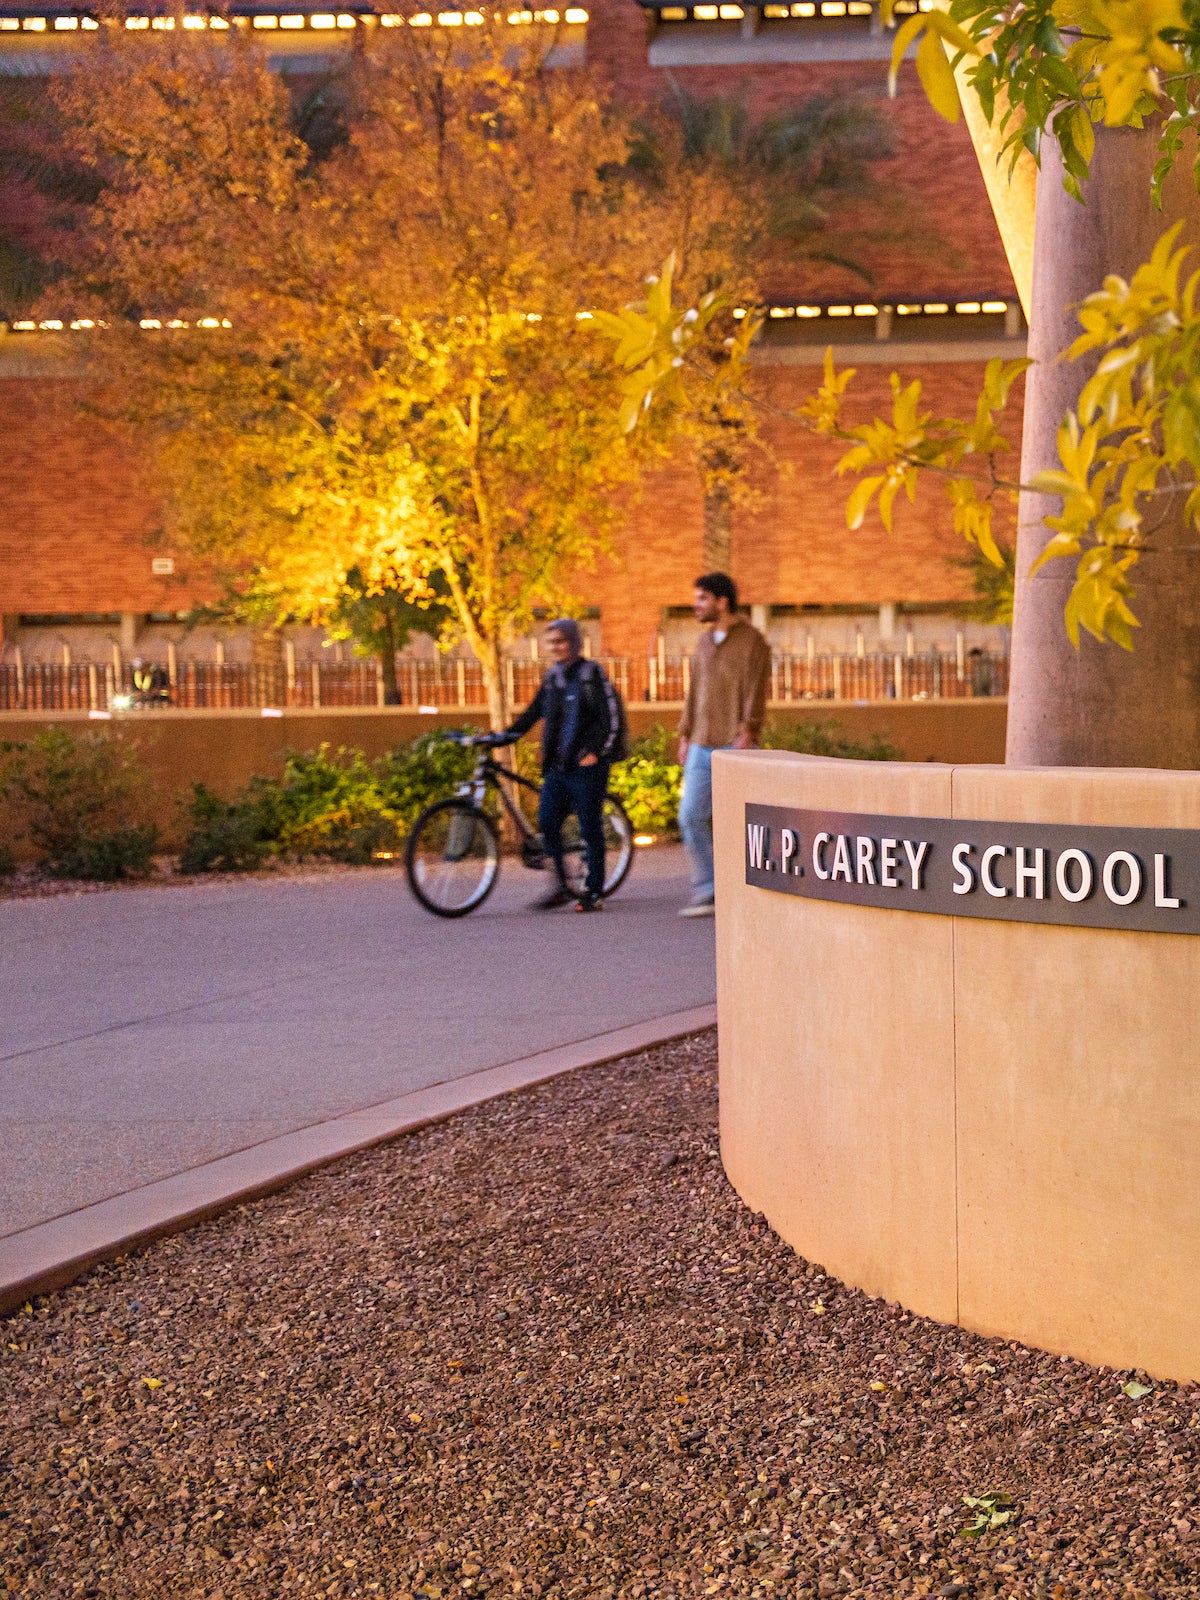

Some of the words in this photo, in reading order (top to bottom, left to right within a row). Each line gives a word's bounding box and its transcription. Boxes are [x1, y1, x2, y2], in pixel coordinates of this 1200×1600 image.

[747, 823, 771, 871] W.
[781, 828, 800, 876] P.
[812, 831, 928, 891] CAREY
[951, 842, 1181, 909] SCHOOL
